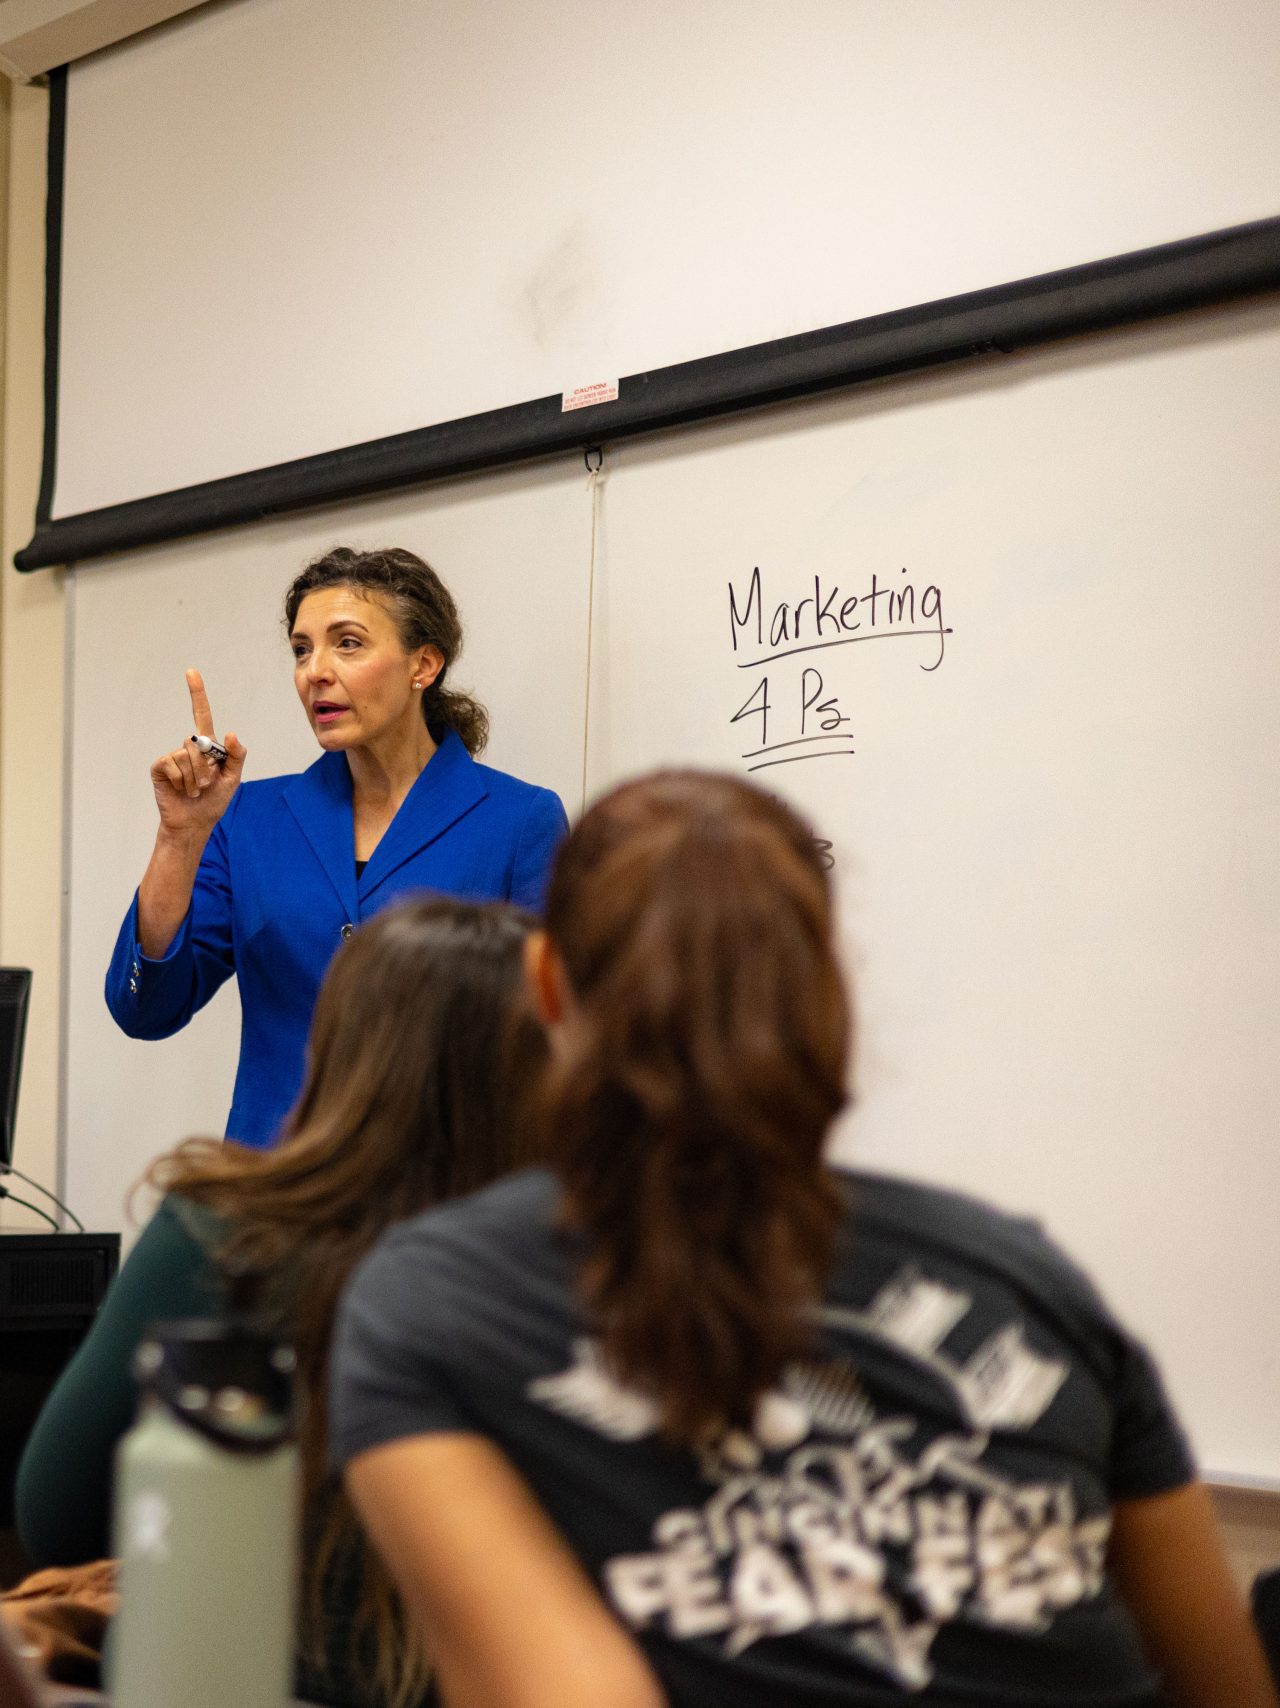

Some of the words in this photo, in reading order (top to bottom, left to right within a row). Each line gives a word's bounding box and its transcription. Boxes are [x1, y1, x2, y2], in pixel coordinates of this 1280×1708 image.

[728, 566, 944, 671] Marketing
[730, 677, 771, 745] 4
[801, 668, 851, 735] Ps
